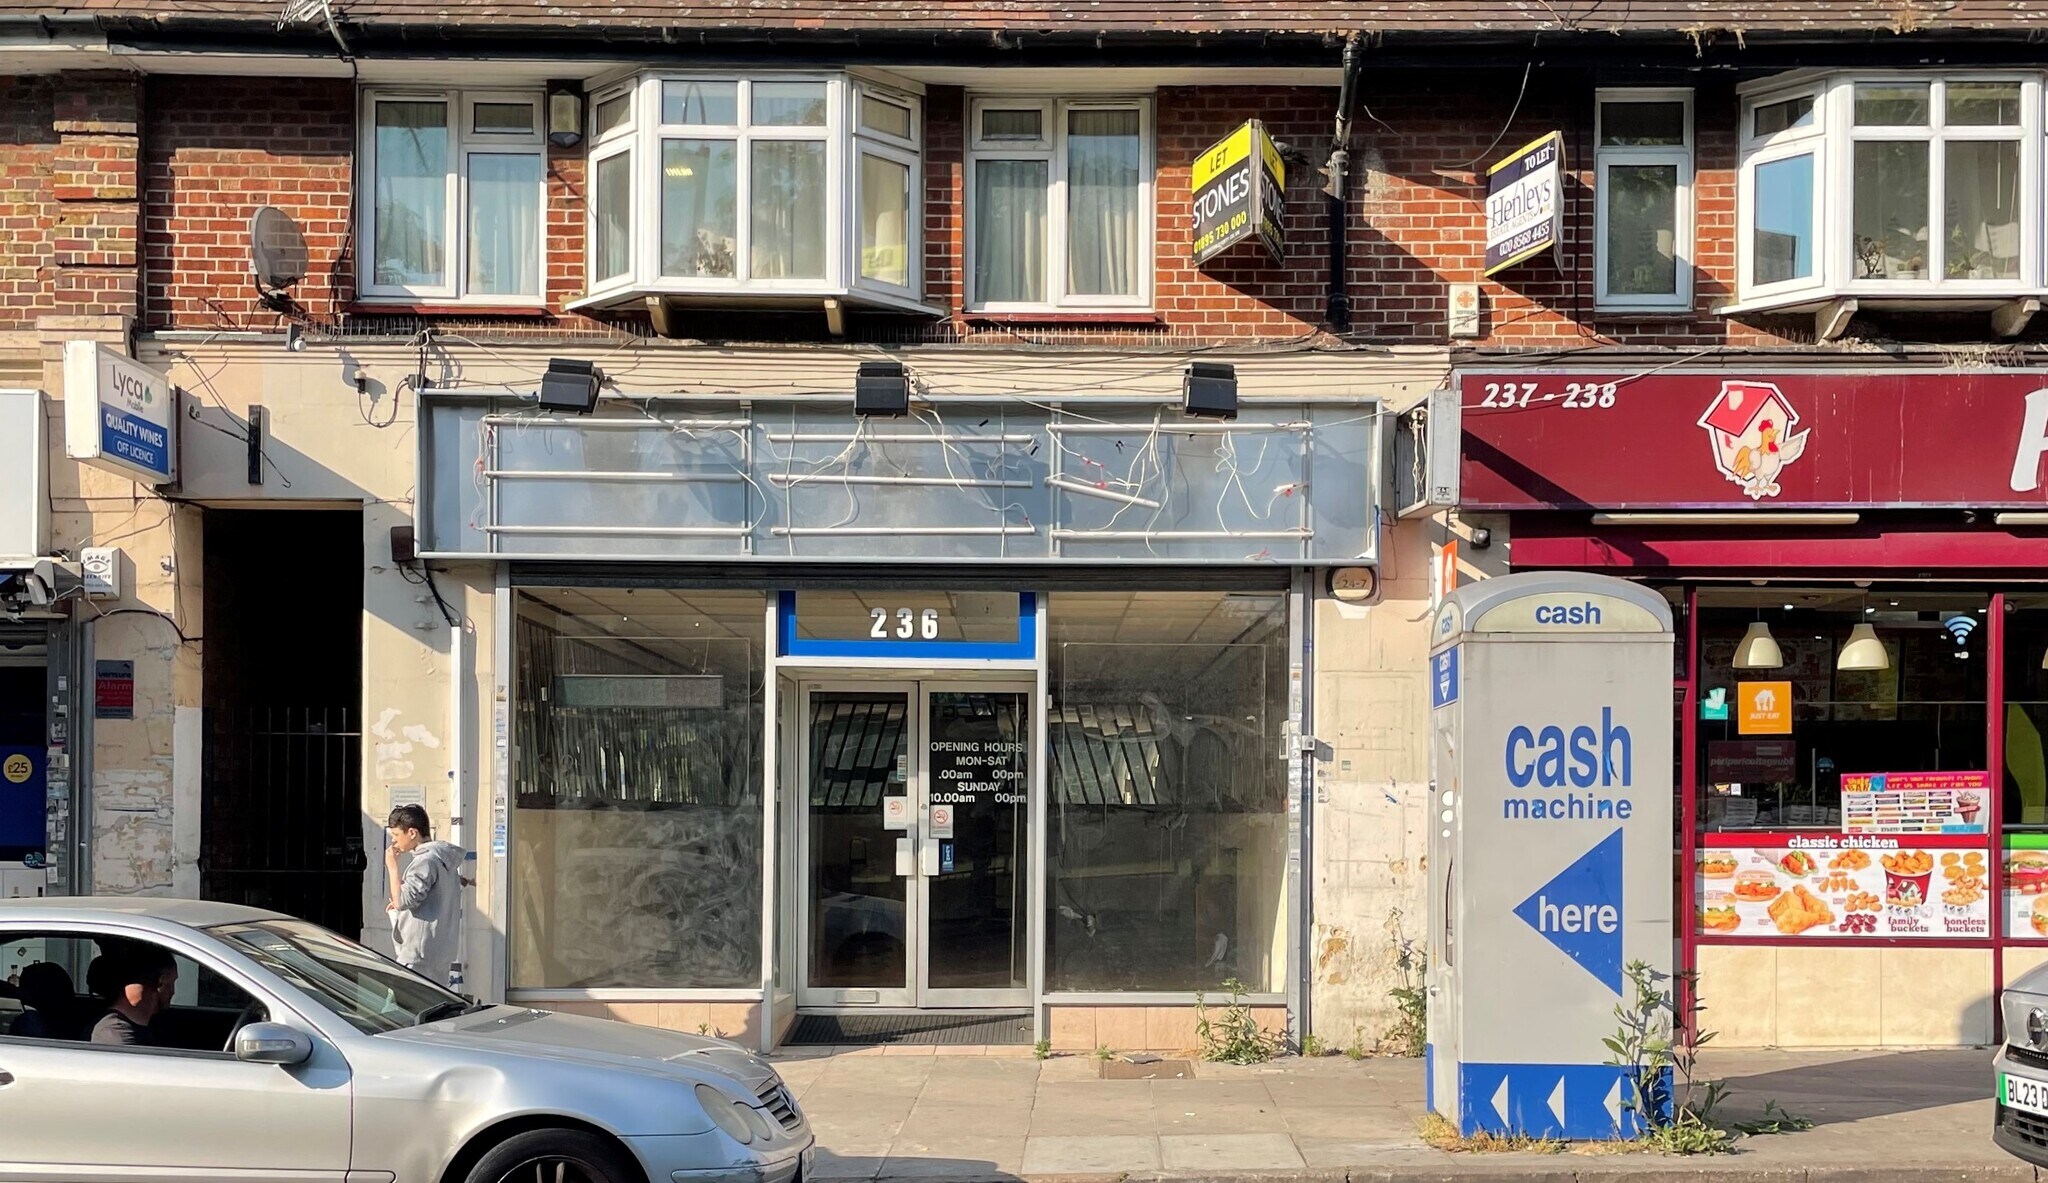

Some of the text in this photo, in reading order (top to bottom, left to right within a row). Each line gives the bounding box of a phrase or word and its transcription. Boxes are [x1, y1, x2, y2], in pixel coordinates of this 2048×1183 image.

[1209, 147, 1229, 174] LET
[1524, 146, 1551, 172] TO LET
[1192, 168, 1250, 229] STONES
[1491, 179, 1551, 229] Henleys
[1193, 231, 1214, 254] 01895
[1215, 221, 1230, 240] 730
[1230, 210, 1247, 230] 000
[1499, 237, 1514, 257] 020
[1531, 220, 1550, 241] 4455
[112, 364, 144, 401] Lyca
[1480, 383, 1539, 408] 237
[1562, 383, 1617, 408] 238
[105, 413, 163, 448] QUALITY WINES
[116, 440, 154, 465] OFF LICENCE
[870, 607, 938, 639] 236
[1535, 601, 1601, 624] cash
[1749, 712, 1766, 720] JUST
[930, 742, 1023, 752] OPENING HOURS
[1505, 706, 1632, 788] cash
[7, 761, 28, 774] £25
[955, 756, 1008, 766] MON-SAT
[957, 782, 1001, 791] SUNDAY
[992, 770, 1024, 781] 00pm
[930, 793, 1027, 804] 10.00am 00pm
[1503, 793, 1633, 819] machine
[1787, 835, 1899, 849] classic chicken
[1538, 895, 1619, 934] here
[1887, 917, 1920, 927] family
[1943, 917, 1987, 926] boneless
[1890, 924, 1929, 933] buckets
[1946, 924, 1985, 932] buckets
[2007, 1079, 2038, 1107] BL23
